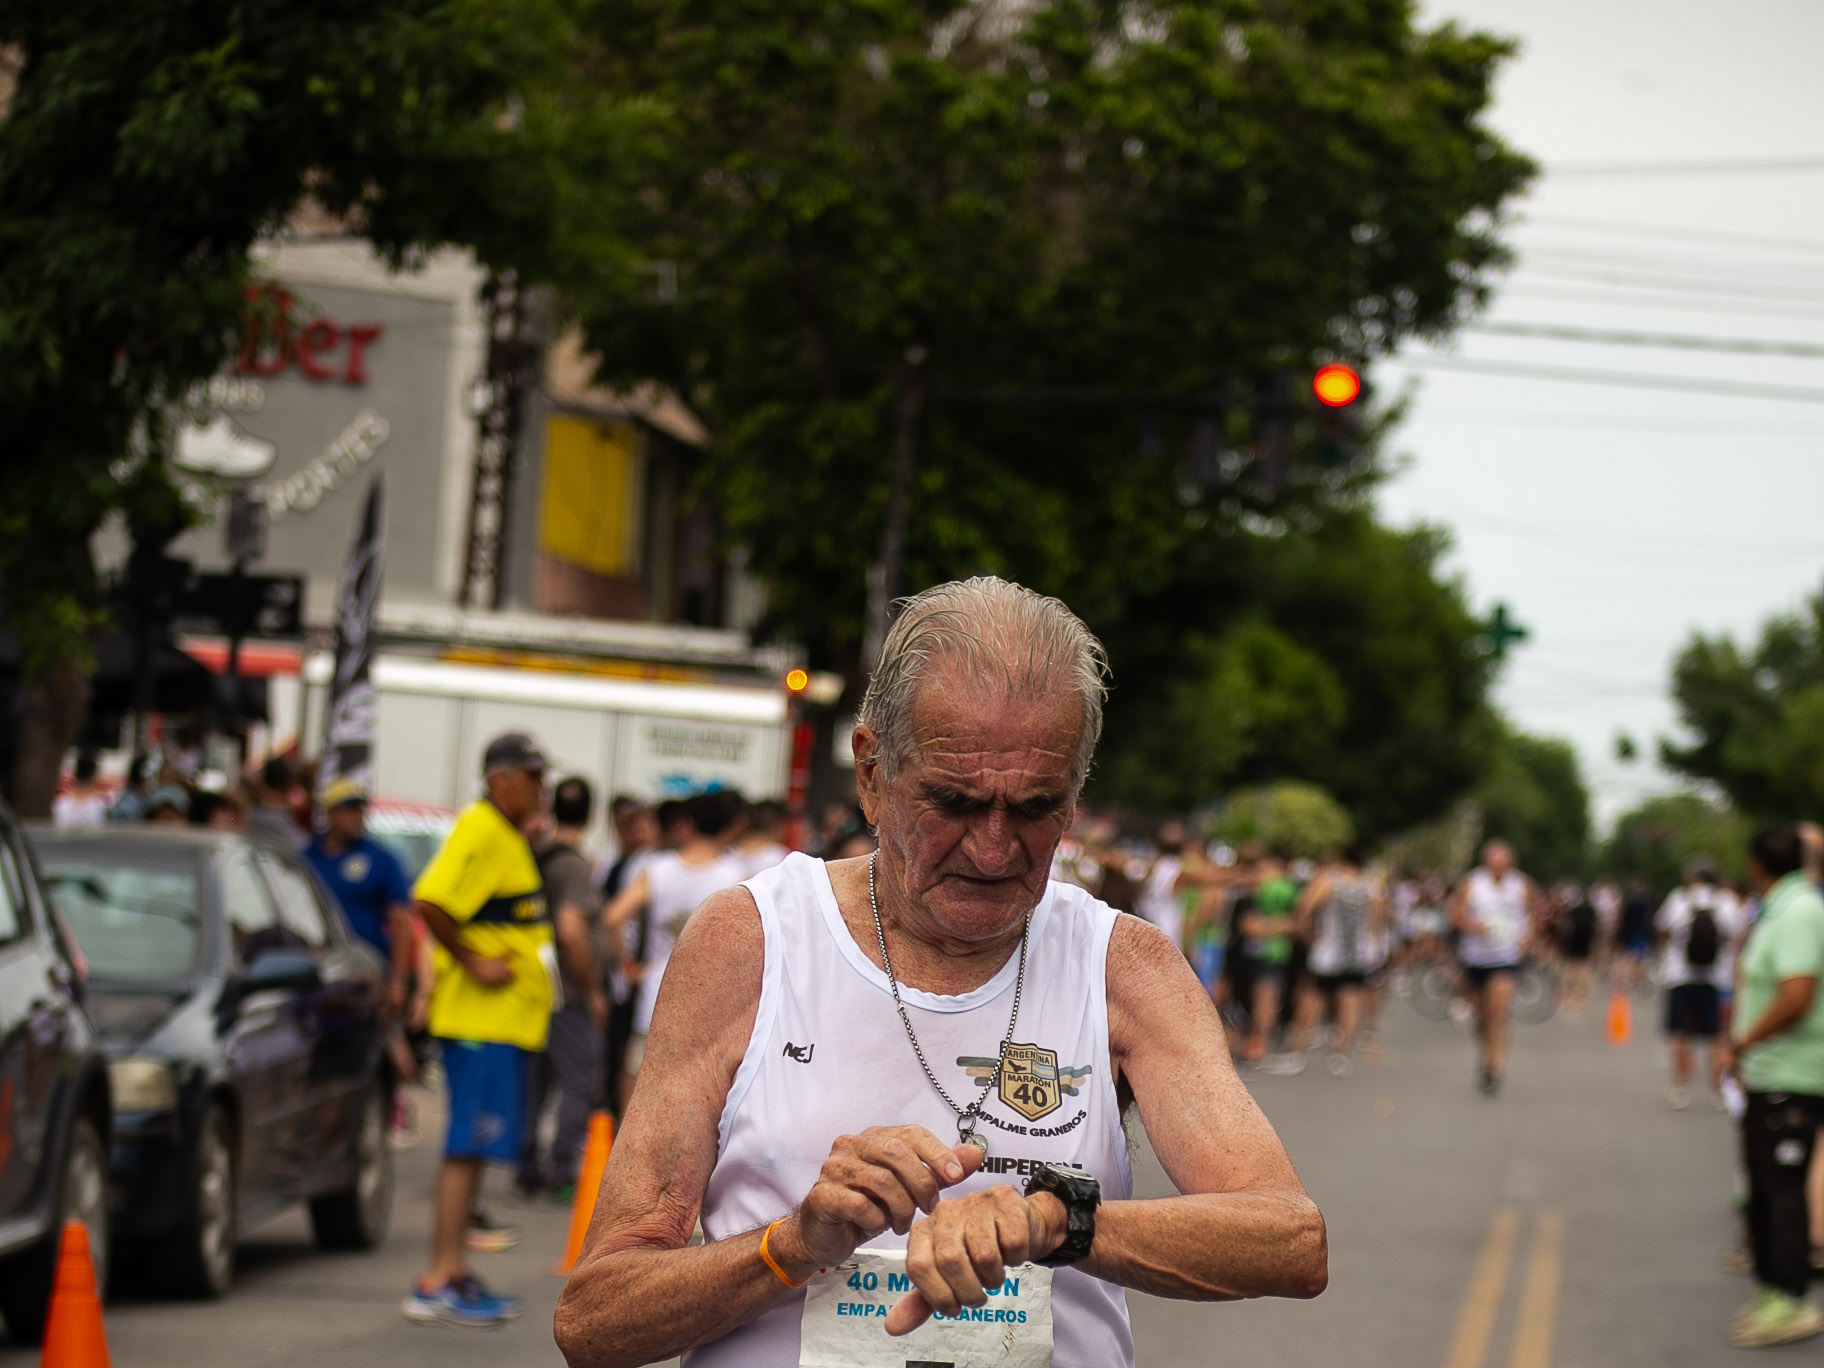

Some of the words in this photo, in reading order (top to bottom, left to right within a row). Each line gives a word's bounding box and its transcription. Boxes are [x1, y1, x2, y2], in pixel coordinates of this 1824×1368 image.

[782, 1041, 815, 1063] NEJ
[1012, 1083, 1048, 1107] 40
[1029, 1109, 1087, 1138] GRANEROS
[846, 1271, 878, 1292] 40
[932, 1307, 1027, 1324] GANEROS
